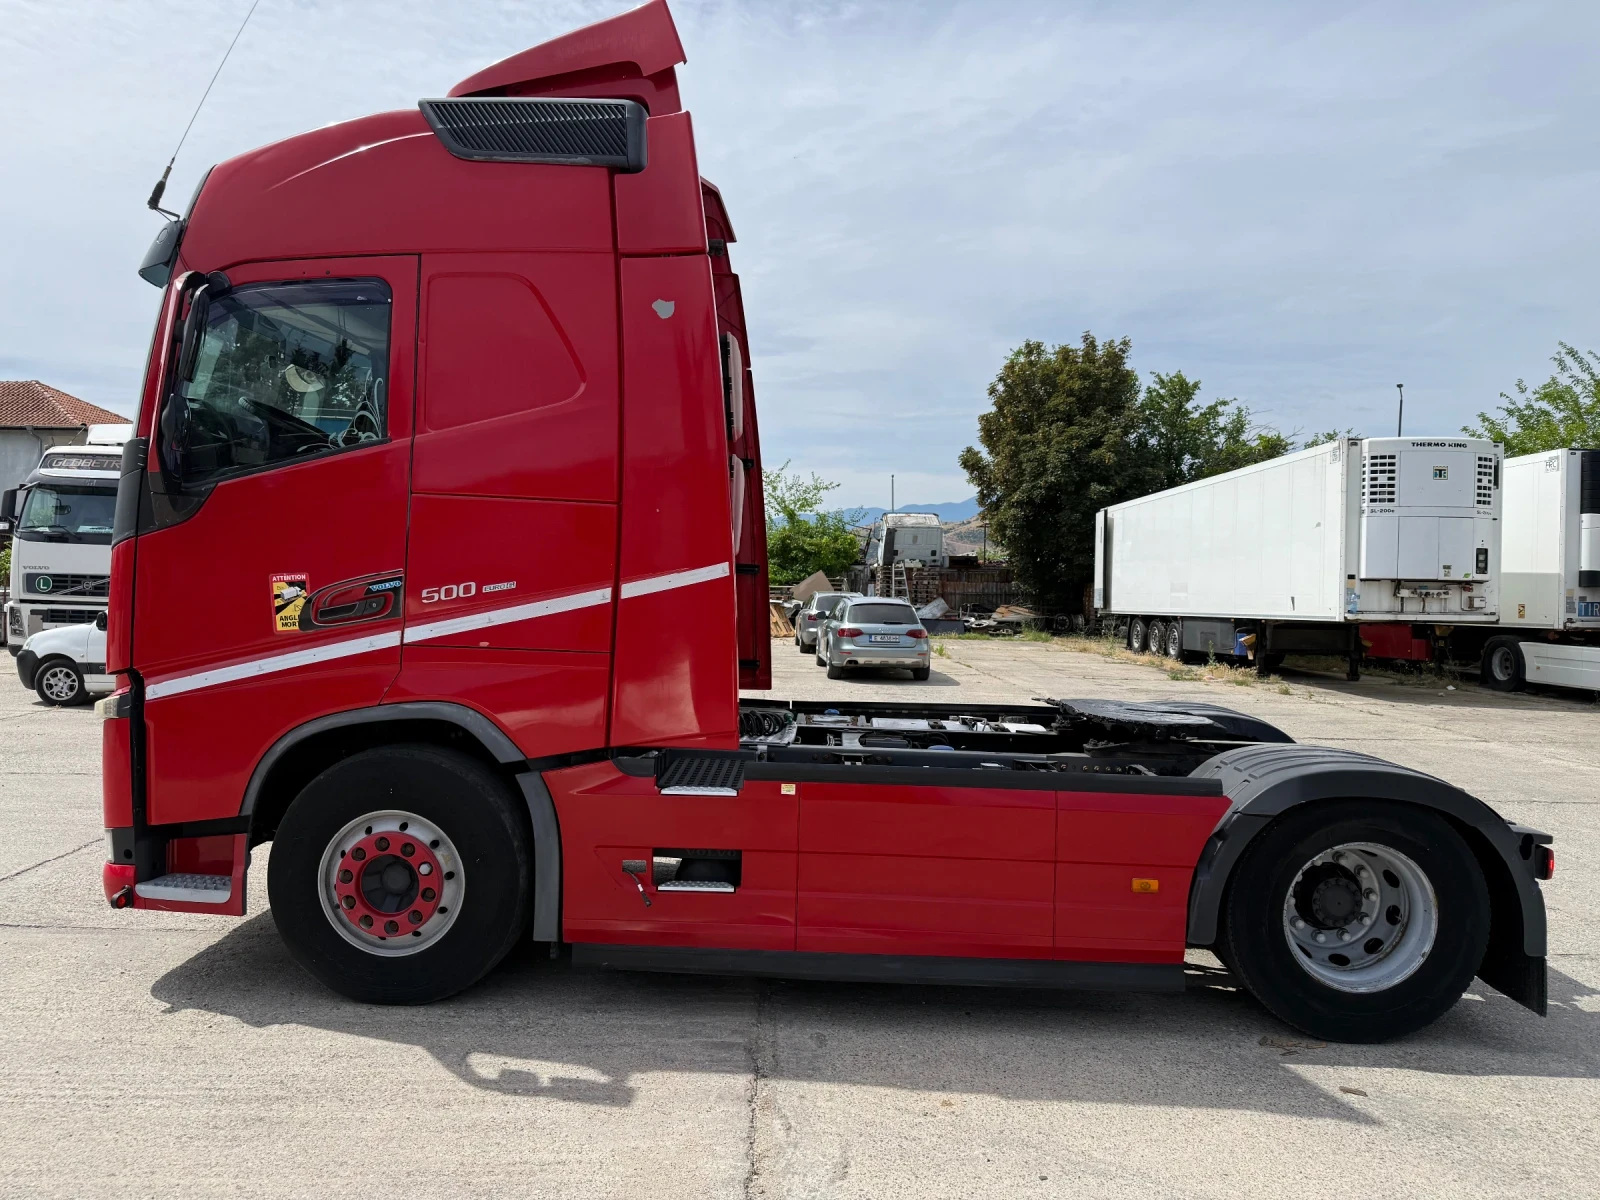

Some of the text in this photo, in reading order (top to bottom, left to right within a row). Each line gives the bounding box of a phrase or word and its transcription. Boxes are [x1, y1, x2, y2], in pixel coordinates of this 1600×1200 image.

[40, 578, 48, 589] L
[369, 580, 402, 592] VOLVO
[421, 581, 476, 603] 500
[1580, 602, 1600, 616] TIR
